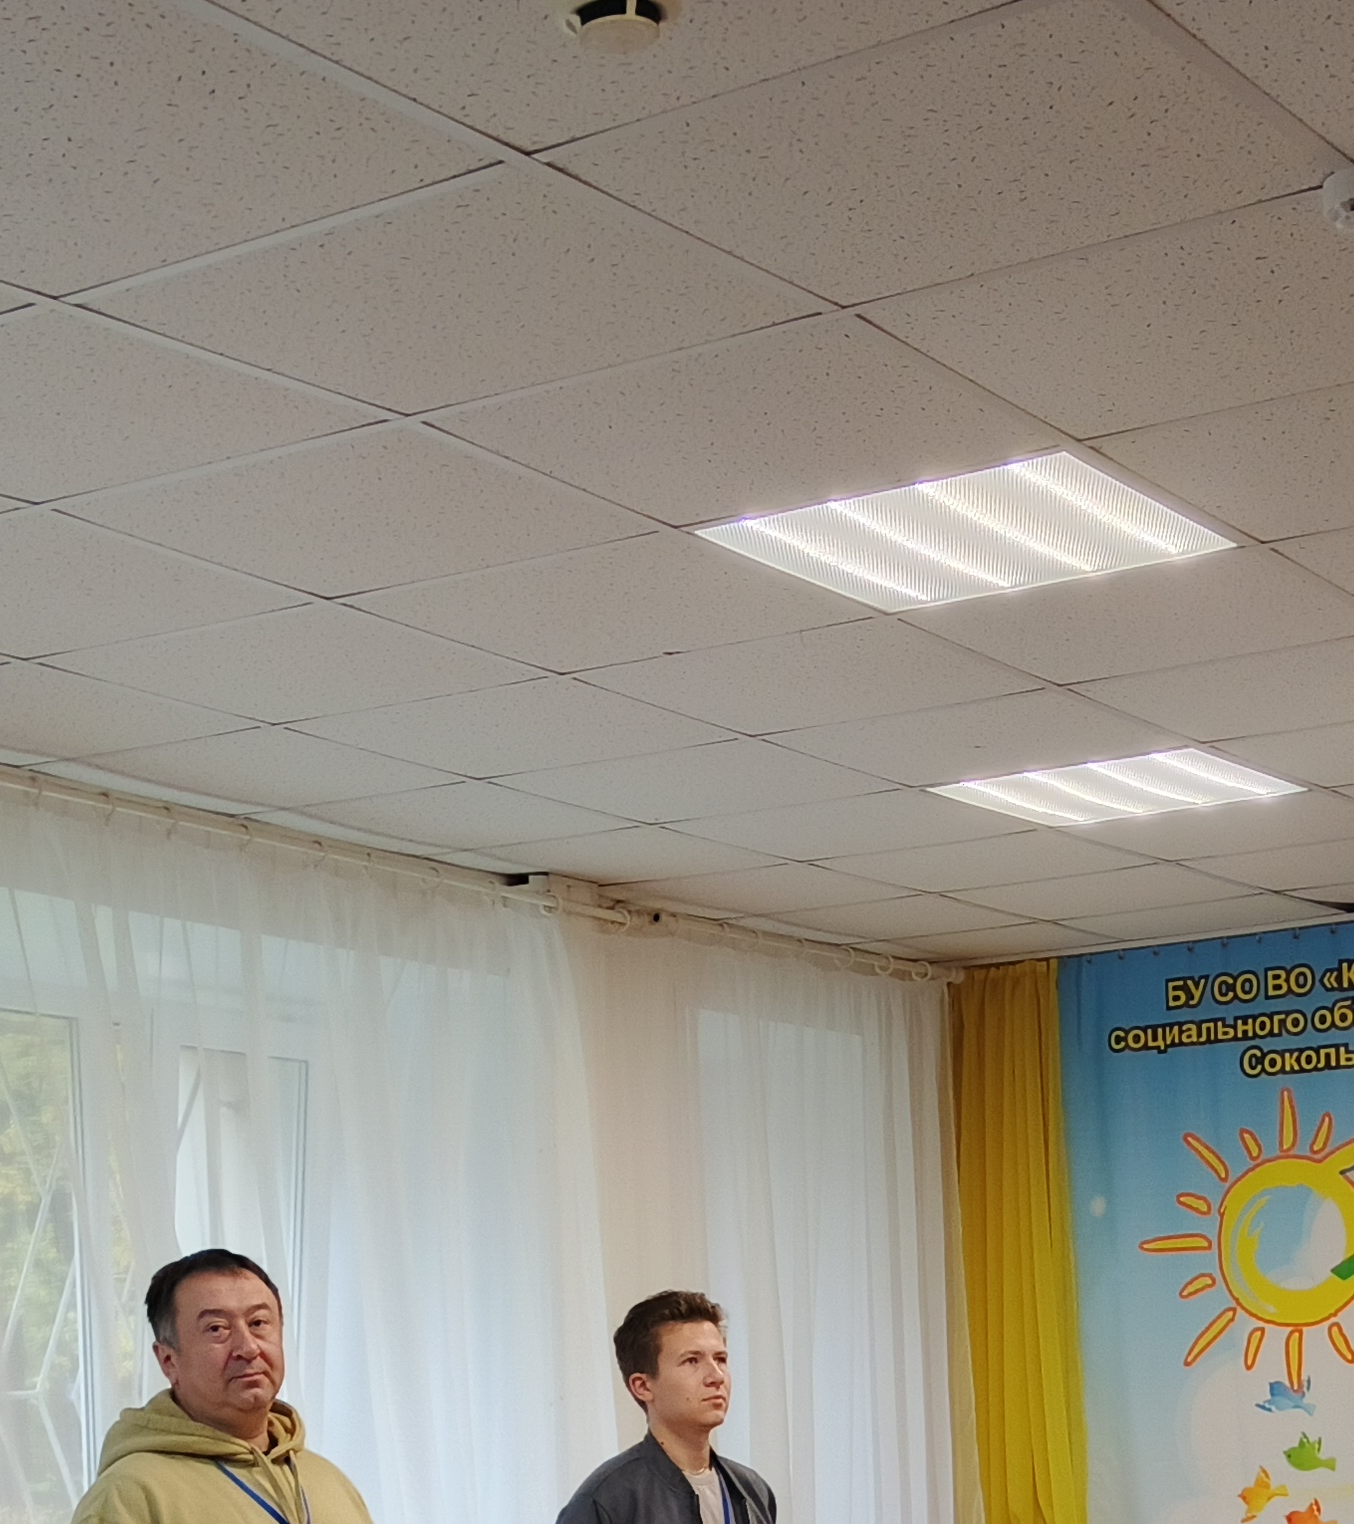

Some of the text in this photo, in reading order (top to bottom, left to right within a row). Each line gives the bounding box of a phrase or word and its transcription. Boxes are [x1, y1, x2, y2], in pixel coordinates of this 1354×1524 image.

[1165, 976, 1208, 1009] БУ
[1212, 971, 1259, 1004] СО
[1266, 965, 1314, 997] ВО
[1109, 1011, 1306, 1051] социального
